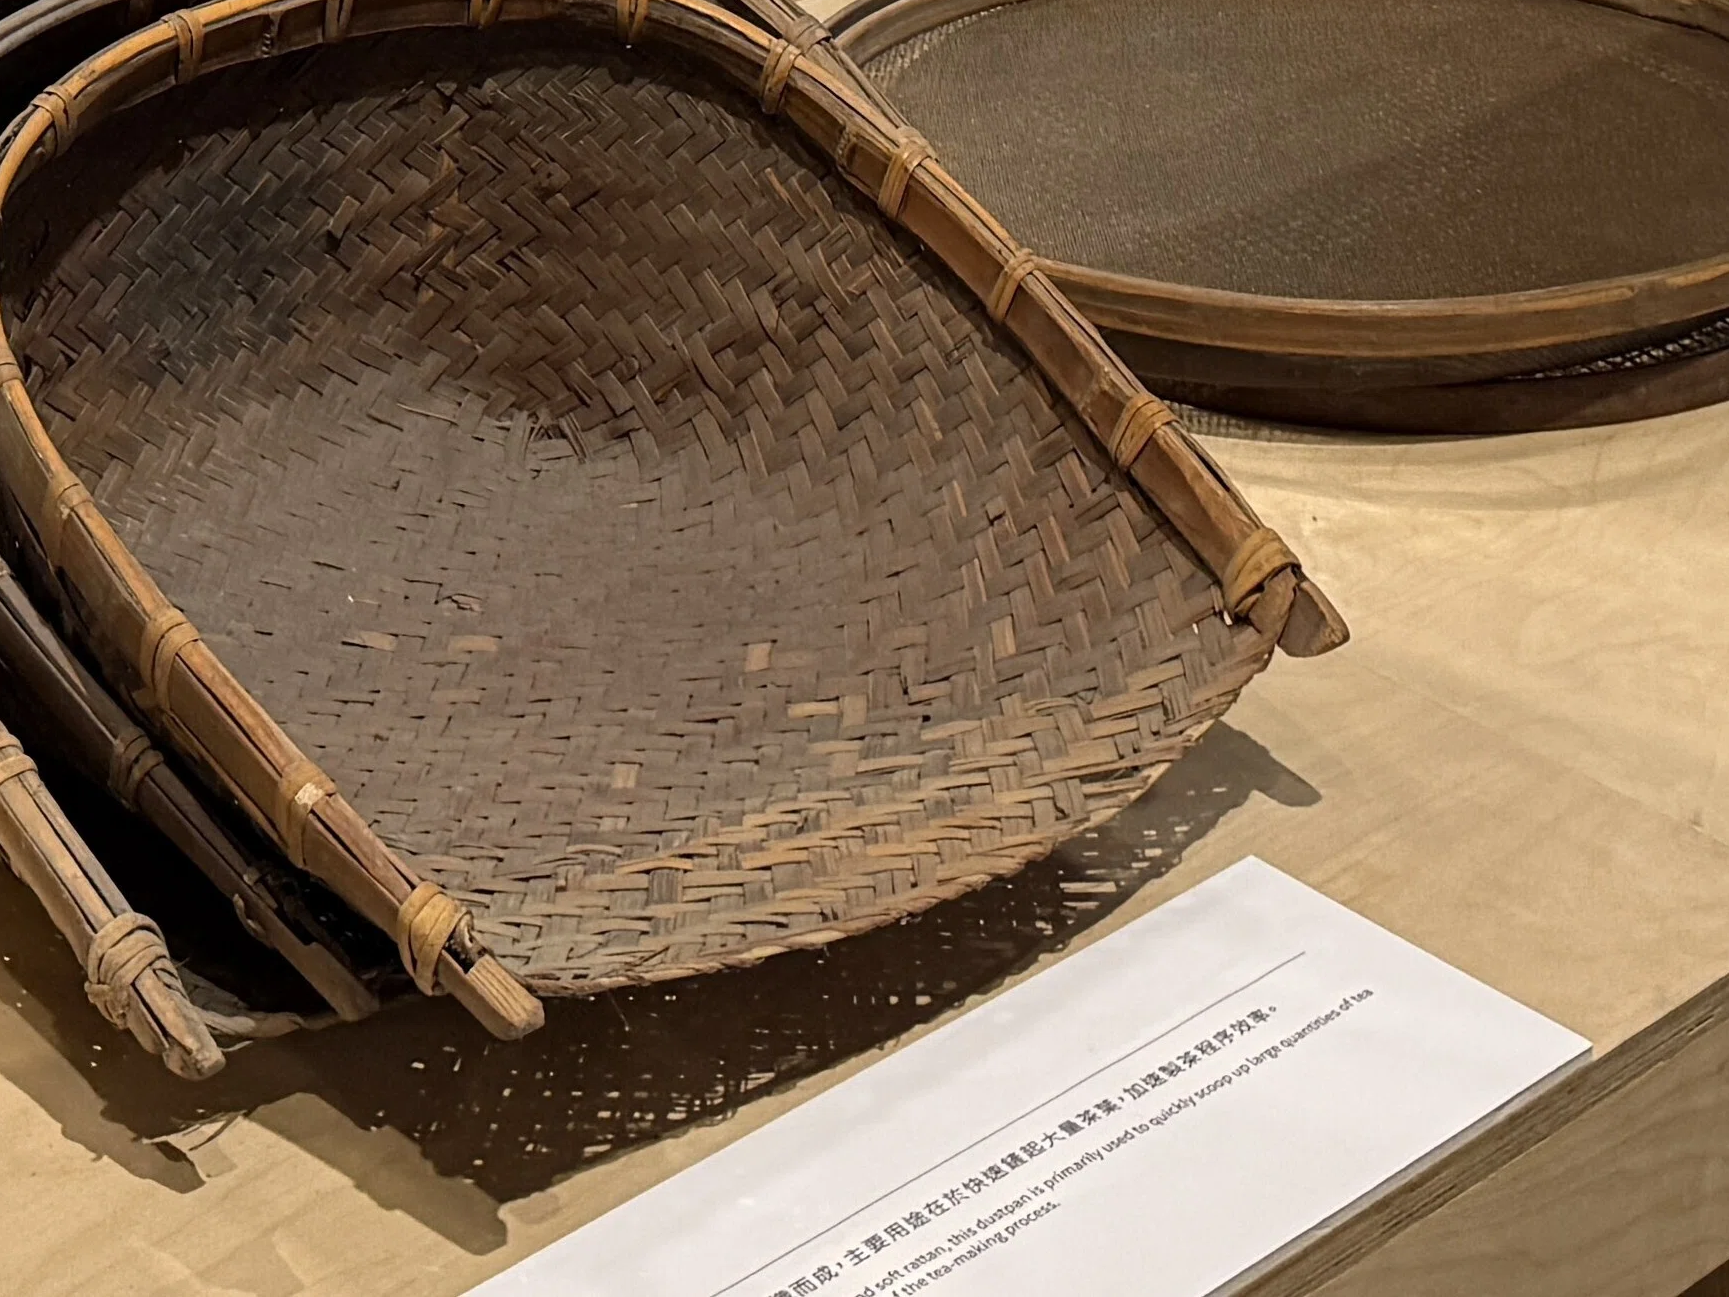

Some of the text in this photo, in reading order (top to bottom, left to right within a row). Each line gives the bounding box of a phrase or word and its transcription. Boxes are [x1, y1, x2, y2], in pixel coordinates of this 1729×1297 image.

[873, 1268, 905, 1291] soft
[902, 1245, 953, 1273] rattan,
[946, 1226, 978, 1246] this
[975, 1193, 1032, 1230] dustpan
[1042, 1148, 1104, 1191] primarily
[1100, 1129, 1135, 1153] used
[1130, 1123, 1150, 1134] to
[1148, 1095, 1197, 1126] quickly
[1192, 1073, 1233, 1099] scoop
[1230, 1063, 1251, 1077] up
[1244, 1044, 1282, 1066] large
[1349, 988, 1374, 1002] tea
[900, 1277, 929, 1296] the
[1003, 1200, 1061, 1237] process.
